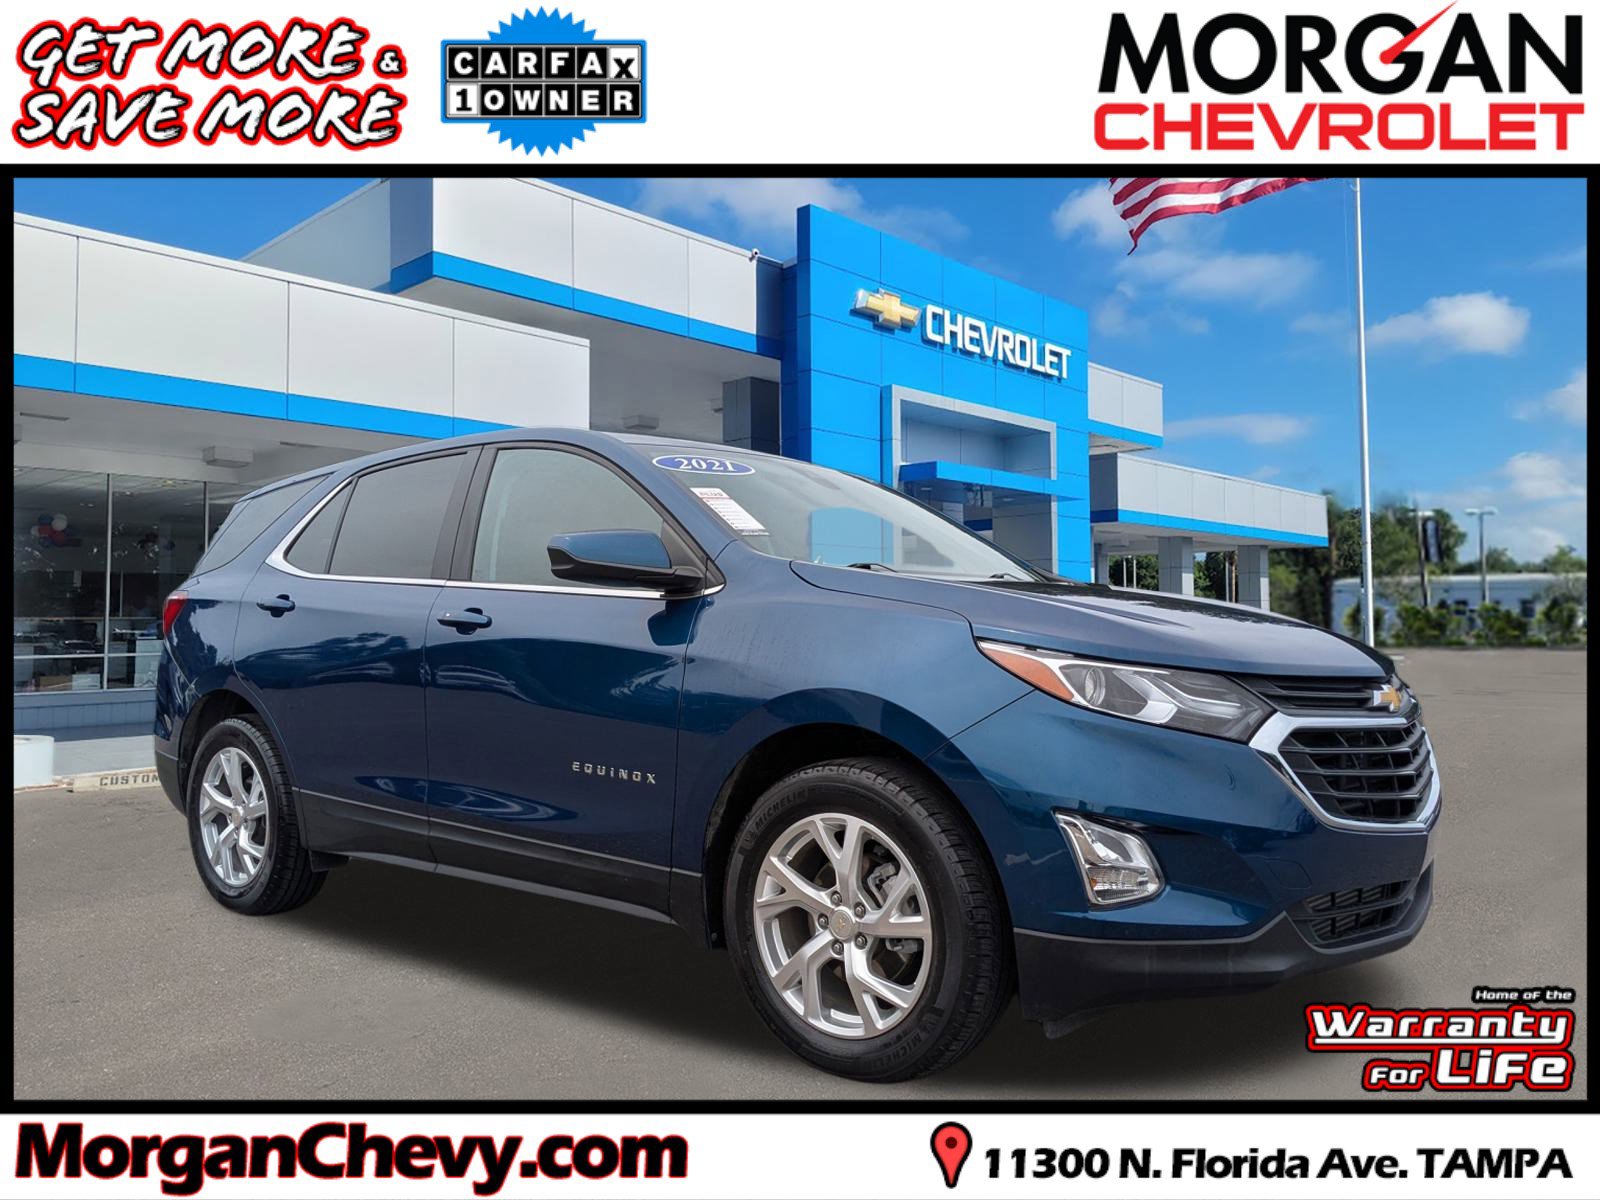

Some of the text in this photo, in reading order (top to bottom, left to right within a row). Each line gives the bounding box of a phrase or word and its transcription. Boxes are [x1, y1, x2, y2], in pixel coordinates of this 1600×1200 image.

[925, 303, 1073, 379] CHEVROLET
[674, 458, 737, 472] 2021
[571, 761, 656, 785] EQUINOX
[754, 788, 807, 830] MICHELIN
